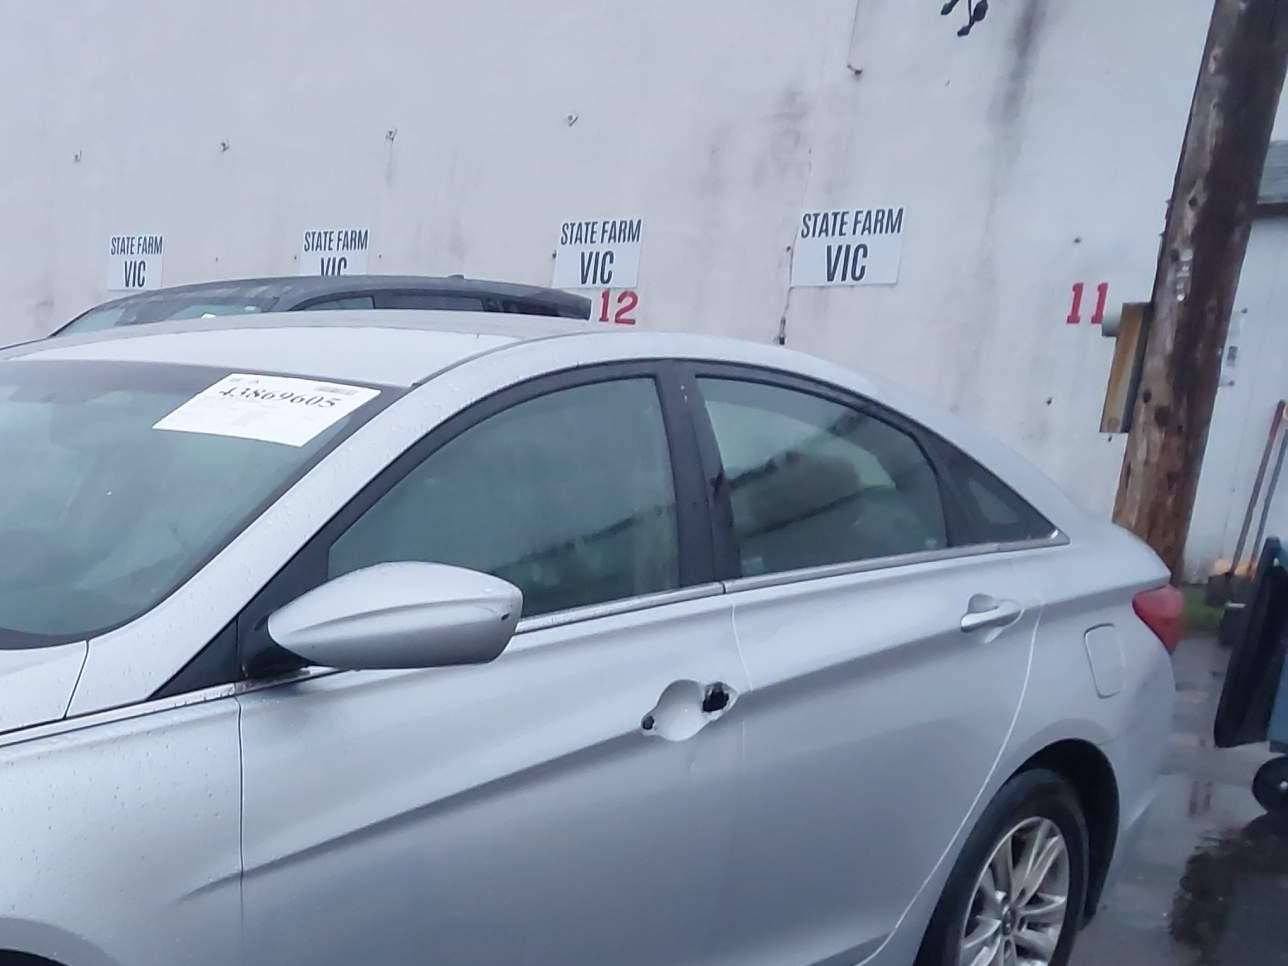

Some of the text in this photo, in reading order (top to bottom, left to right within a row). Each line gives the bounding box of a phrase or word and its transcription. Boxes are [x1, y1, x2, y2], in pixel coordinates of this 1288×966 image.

[561, 218, 642, 246] STATE FARM
[800, 207, 904, 239] STATE FARM
[110, 236, 163, 256] STATE FARM
[303, 229, 369, 253] STATE FARM
[124, 259, 147, 288] VIC
[320, 256, 348, 277] VIC
[579, 250, 615, 286] VIC
[825, 243, 869, 283] VIC
[598, 290, 639, 325] 12
[1066, 281, 1109, 325] 11
